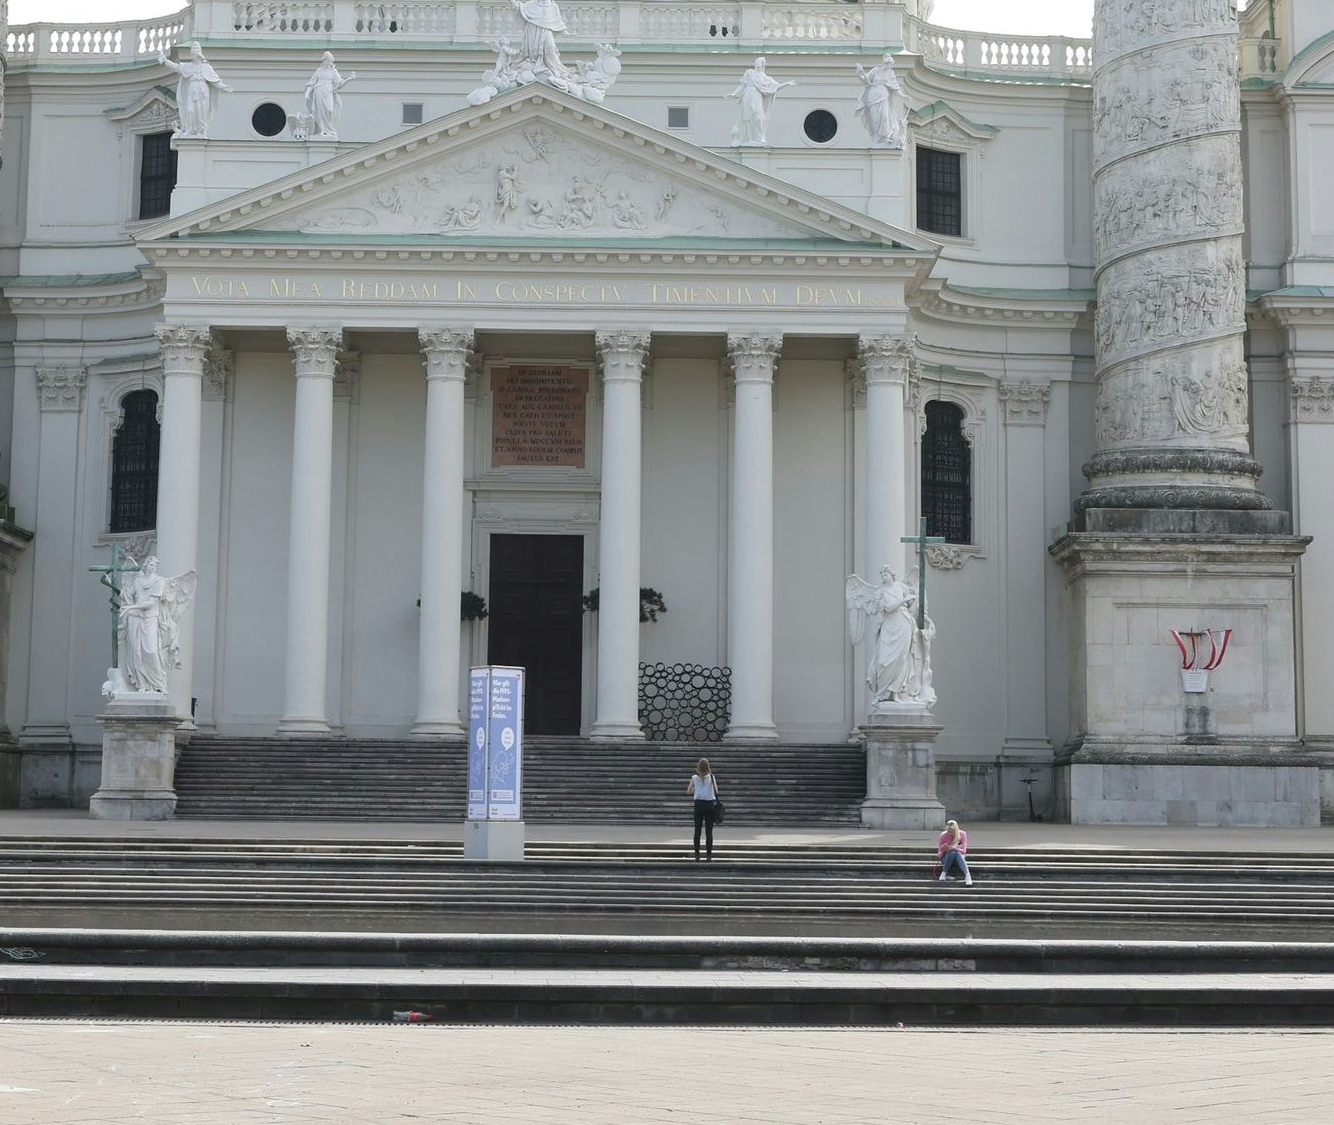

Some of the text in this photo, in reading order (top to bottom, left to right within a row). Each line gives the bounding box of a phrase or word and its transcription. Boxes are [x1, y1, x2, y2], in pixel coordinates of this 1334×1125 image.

[191, 276, 250, 297] VOTA
[269, 278, 323, 298] MEA
[342, 278, 438, 299] REDDAM
[457, 281, 476, 300] IN
[647, 283, 777, 303] TIMENTIVM
[795, 285, 863, 305] DEVM
